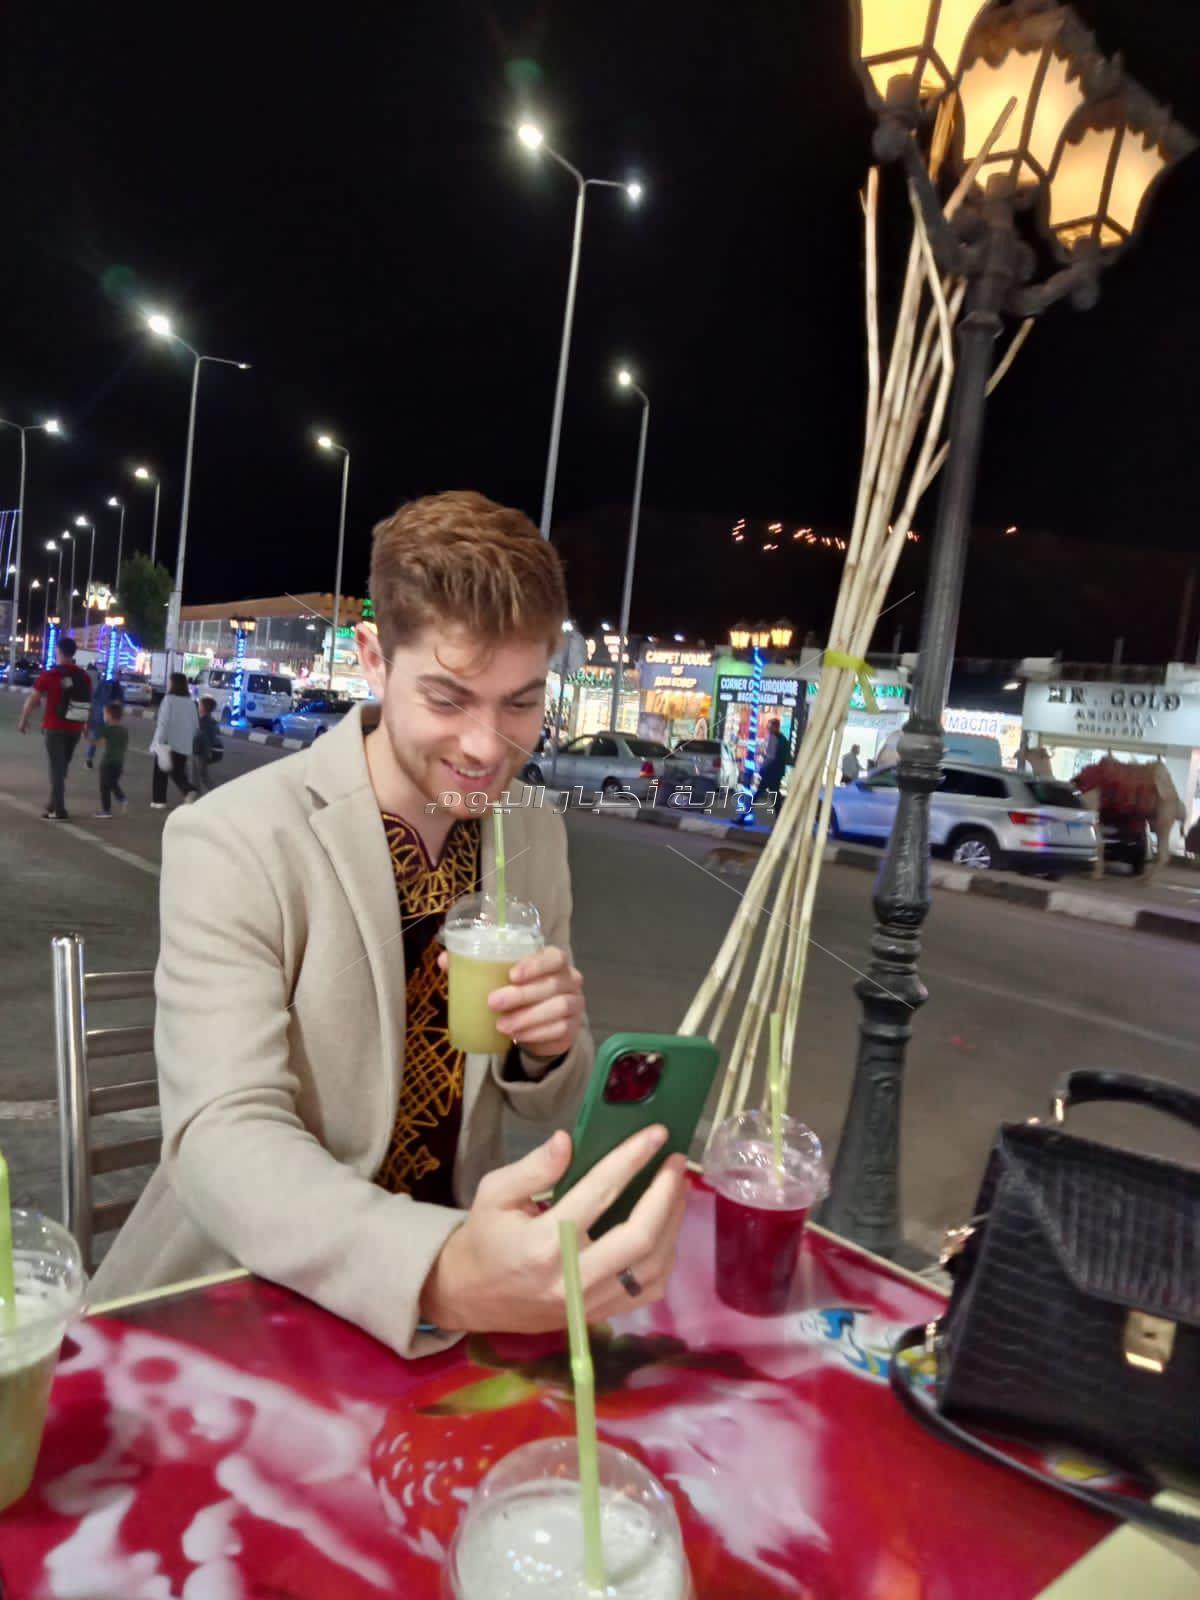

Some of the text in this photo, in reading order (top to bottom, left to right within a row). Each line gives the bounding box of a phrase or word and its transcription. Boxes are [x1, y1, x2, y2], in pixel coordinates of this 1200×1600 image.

[646, 650, 680, 664] CARPET
[721, 678, 747, 690] CORNER
[1111, 687, 1182, 711] GOLD
